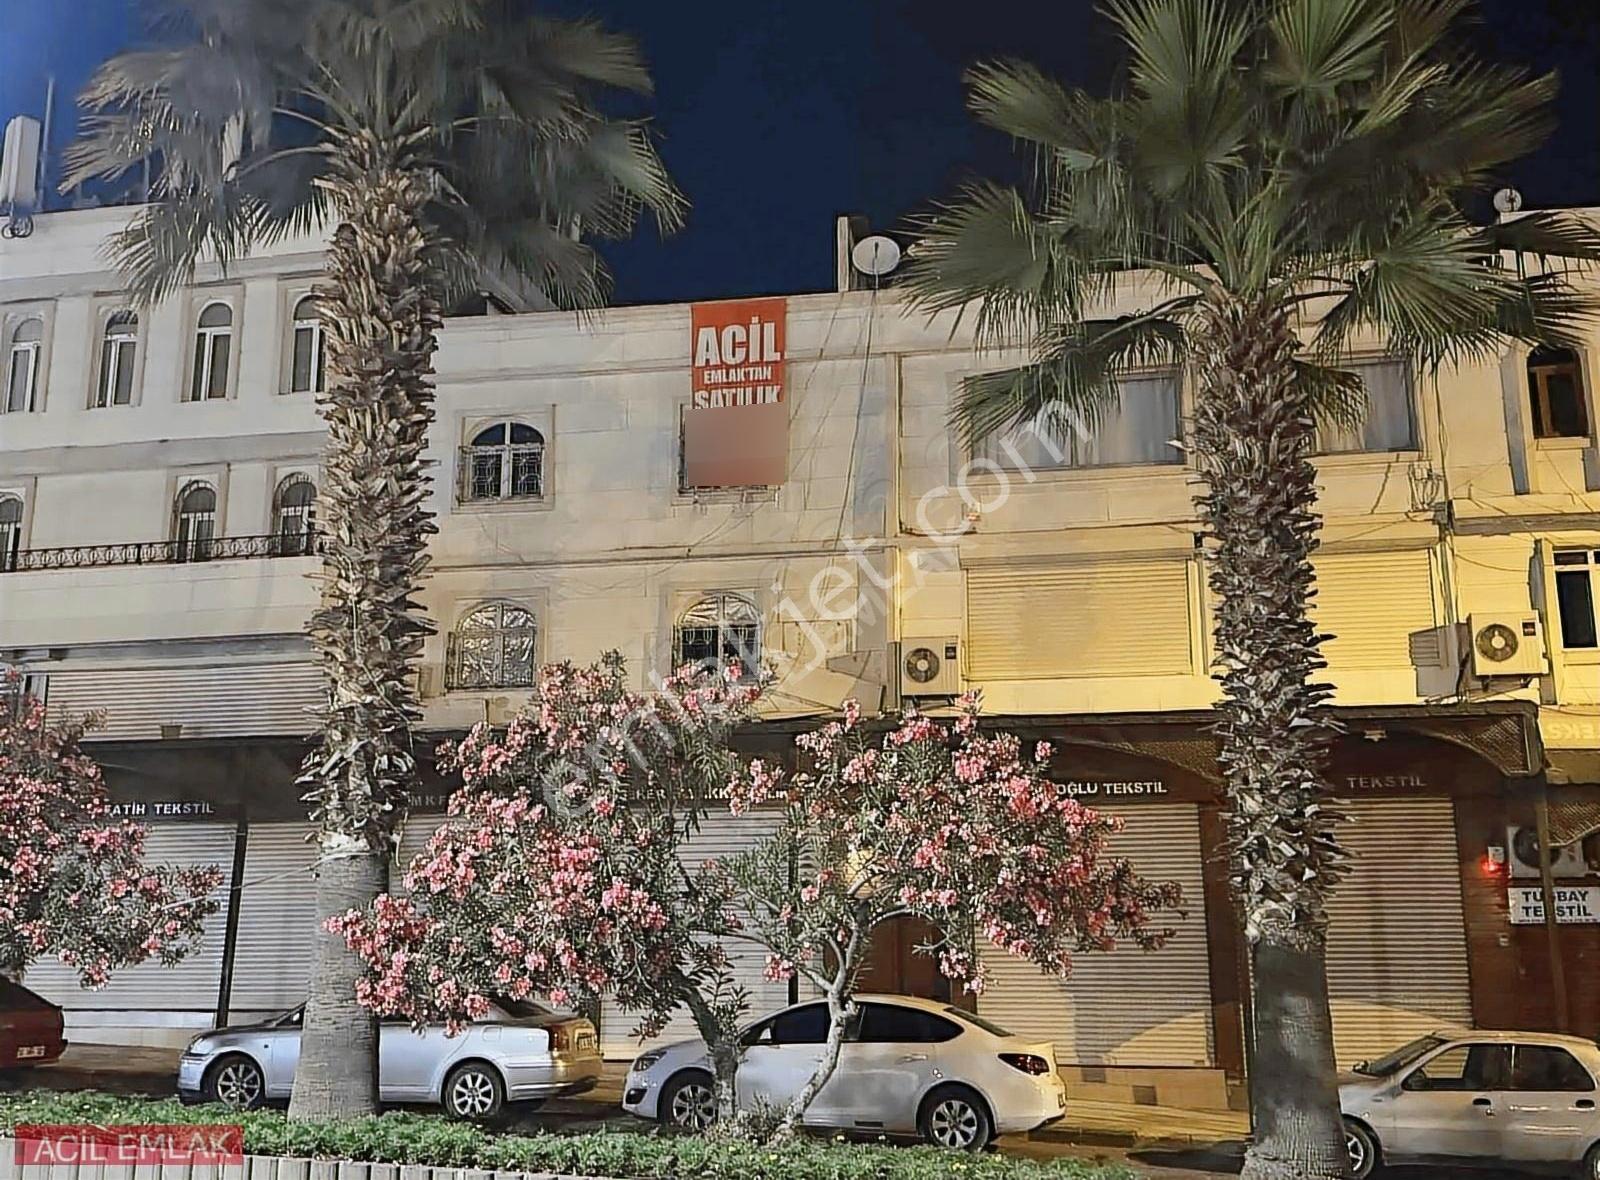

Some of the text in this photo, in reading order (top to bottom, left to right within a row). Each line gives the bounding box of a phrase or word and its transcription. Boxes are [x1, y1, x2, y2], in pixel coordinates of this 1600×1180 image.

[695, 316, 781, 366] ACİL
[1056, 781, 1098, 797] OĞLU
[1521, 890, 1589, 902] TUBAY
[1521, 904, 1592, 917] TESTİL
